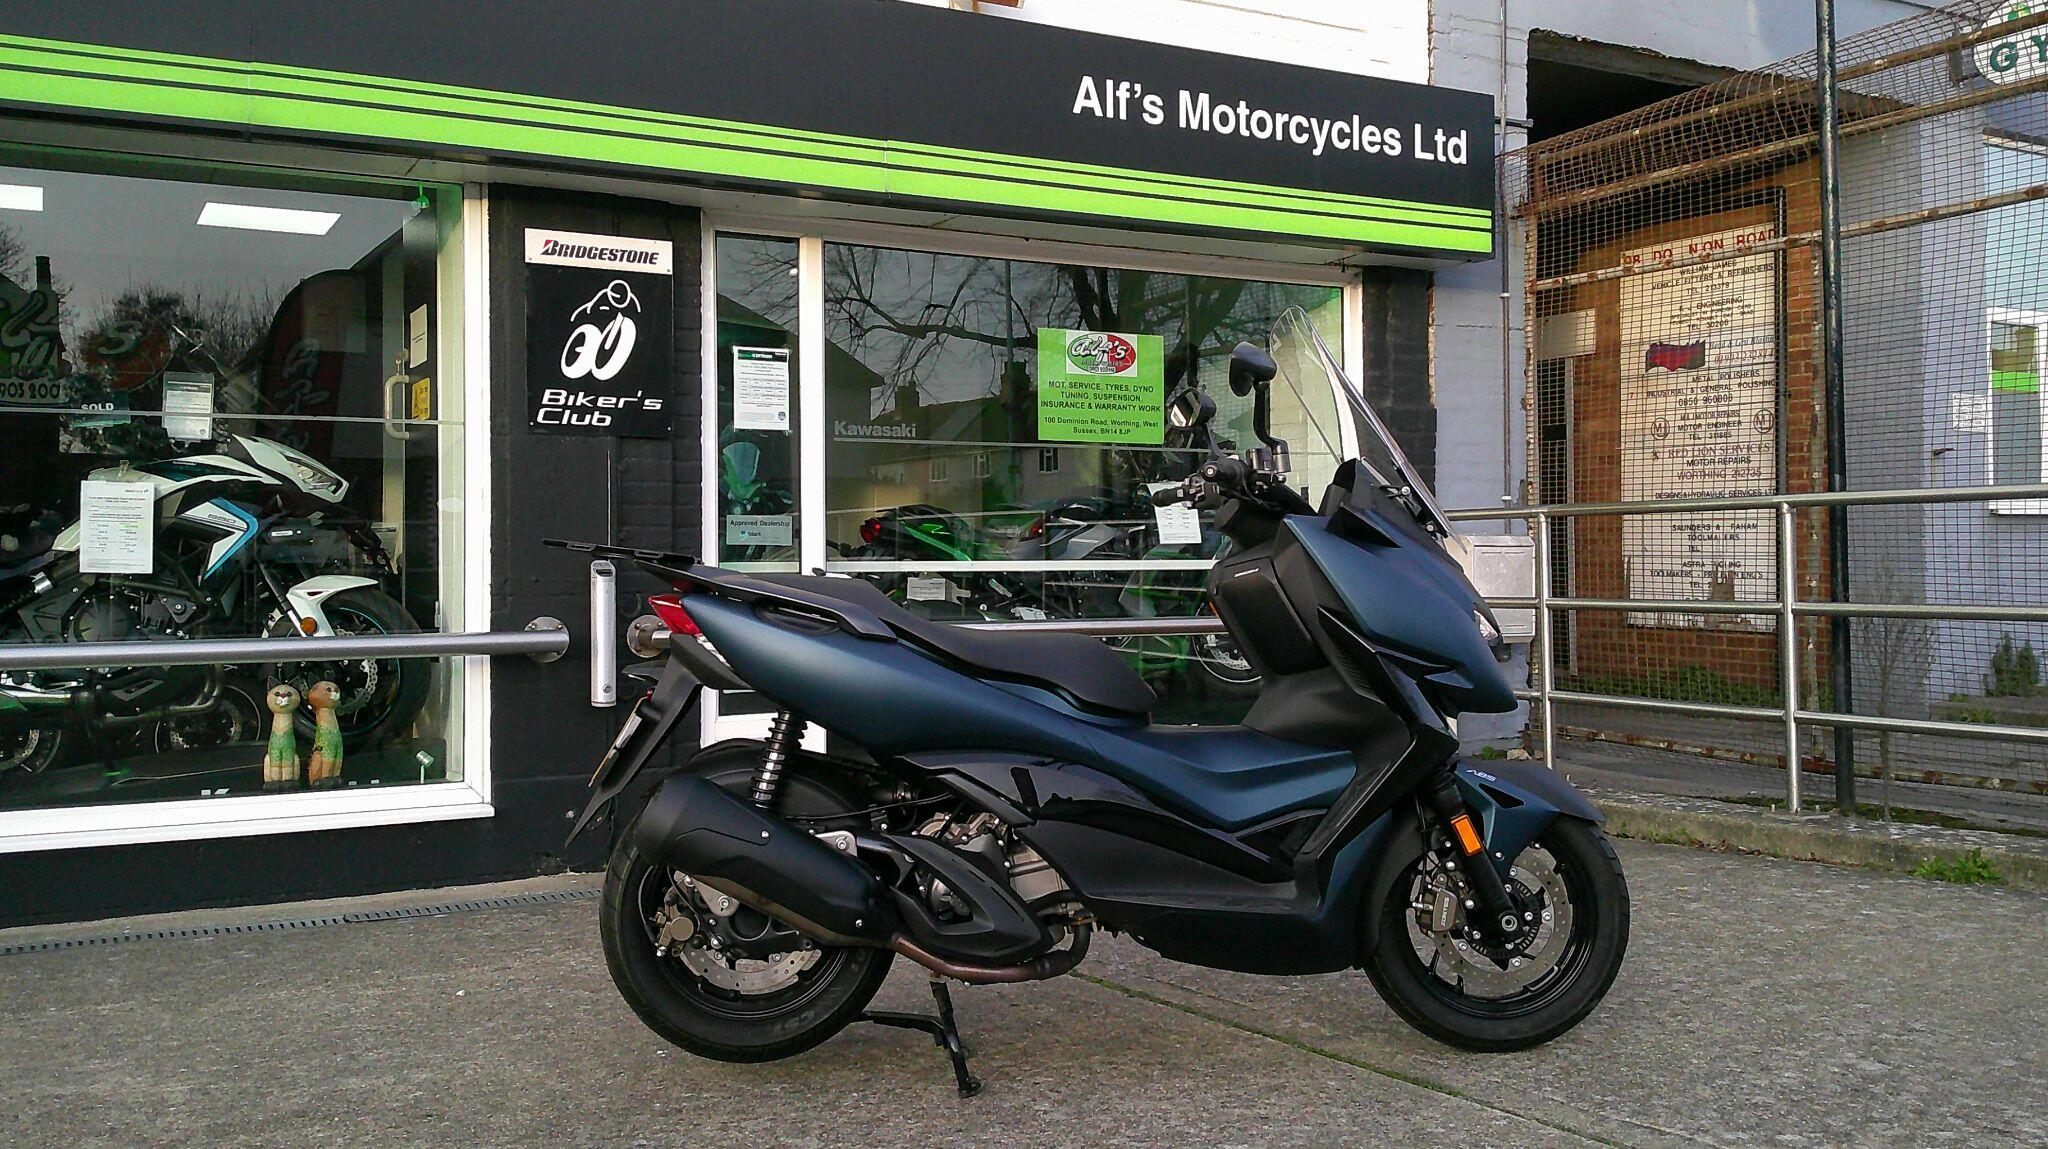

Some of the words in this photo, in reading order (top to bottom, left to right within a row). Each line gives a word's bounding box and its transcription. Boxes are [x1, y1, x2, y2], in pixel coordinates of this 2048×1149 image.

[1072, 75, 1164, 126] Alf's
[1178, 88, 1401, 156] Motorcycles
[1413, 123, 1468, 165] Ltd
[540, 239, 659, 265] BRIDGESTONE
[1680, 264, 1709, 275] WILLIAM
[1711, 260, 1737, 270] JAMES
[1652, 279, 1680, 290] VEHICLE
[1696, 296, 1743, 309] ENGINEERING
[1692, 375, 1715, 383] METAL
[1720, 370, 1760, 380] POLISHERS
[1133, 385, 1154, 393] DYNO
[1646, 388, 1686, 397] INDUSTRIAL
[1699, 383, 1733, 393] GENERAL
[1737, 378, 1776, 389] POLISHING
[541, 388, 664, 411] Biker's
[81, 402, 114, 411] SOLD
[1040, 400, 1085, 410] INSURANCE
[1087, 402, 1093, 410] &
[1095, 402, 1137, 412] WARRANTY
[1138, 404, 1161, 412] WORK
[536, 407, 612, 427] Club
[1044, 416, 1056, 424] 100
[1057, 416, 1089, 425] Dominion
[1143, 420, 1159, 428] West
[834, 420, 917, 438] Kawasaki
[1100, 427, 1118, 435] BN14
[1677, 423, 1702, 431] MOTOR
[1707, 420, 1742, 430] ENGINEER
[1668, 448, 1689, 459] RED
[1692, 446, 1716, 457] LION
[1719, 442, 1771, 455] SERVICES
[1686, 458, 1715, 467] MOTOR
[1718, 456, 1752, 466] REPAIRS
[1677, 469, 1727, 480] WORTHING
[1728, 488, 1762, 497] SERVICES
[730, 519, 758, 527] Approved
[759, 519, 790, 527] Dealership
[1672, 523, 1711, 531] SAUNDERS
[1687, 533, 1740, 541] TOOLMAERS
[1682, 560, 1706, 568] ASTRA
[1650, 569, 1693, 578] TOOLMAKERS
